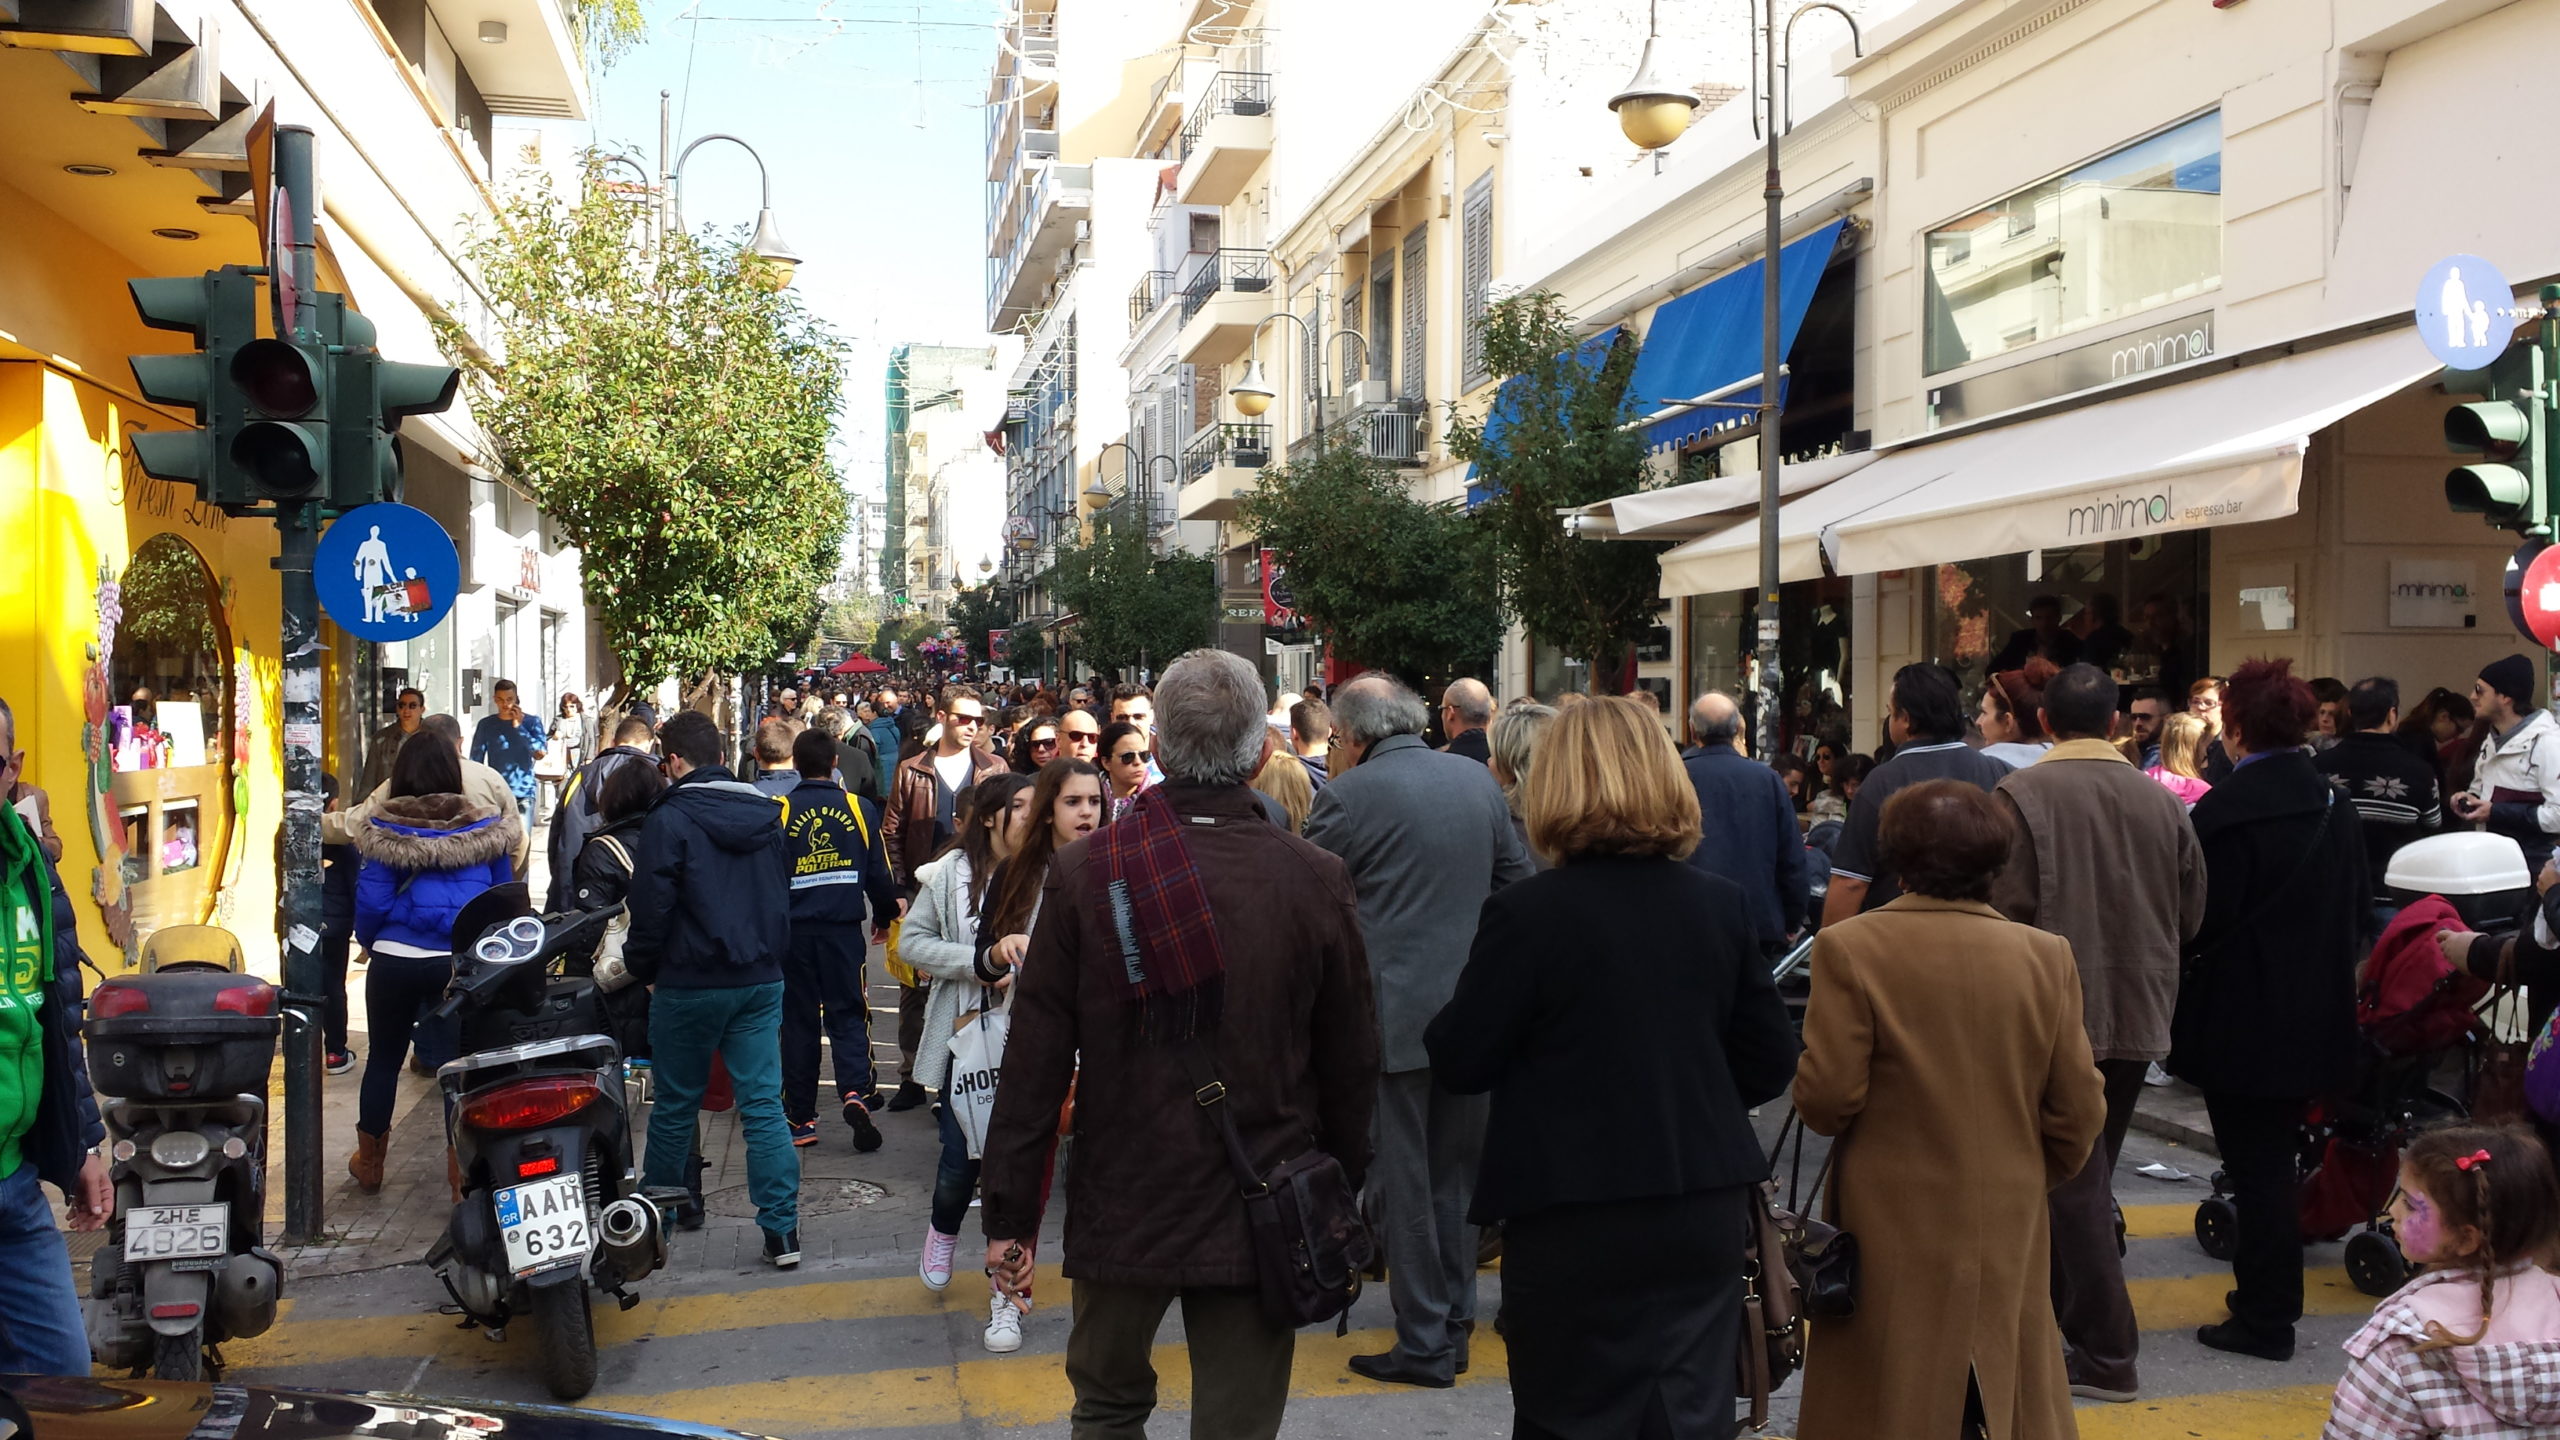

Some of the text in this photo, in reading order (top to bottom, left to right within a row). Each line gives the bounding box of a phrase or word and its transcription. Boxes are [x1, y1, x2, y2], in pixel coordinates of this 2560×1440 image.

[2112, 322, 2213, 379] minimal
[183, 502, 228, 534] Line
[2067, 485, 2244, 537] minimal espresso bar
[2398, 582, 2469, 597] minimal
[795, 859, 853, 875] POLO TEAM
[797, 852, 839, 866] WATER
[954, 1067, 1001, 1095] SHOP
[152, 1208, 201, 1225] ZHE
[523, 1185, 580, 1221] AAH
[502, 1212, 519, 1225] GR
[129, 1225, 221, 1256] 4826
[525, 1220, 587, 1257] 632
